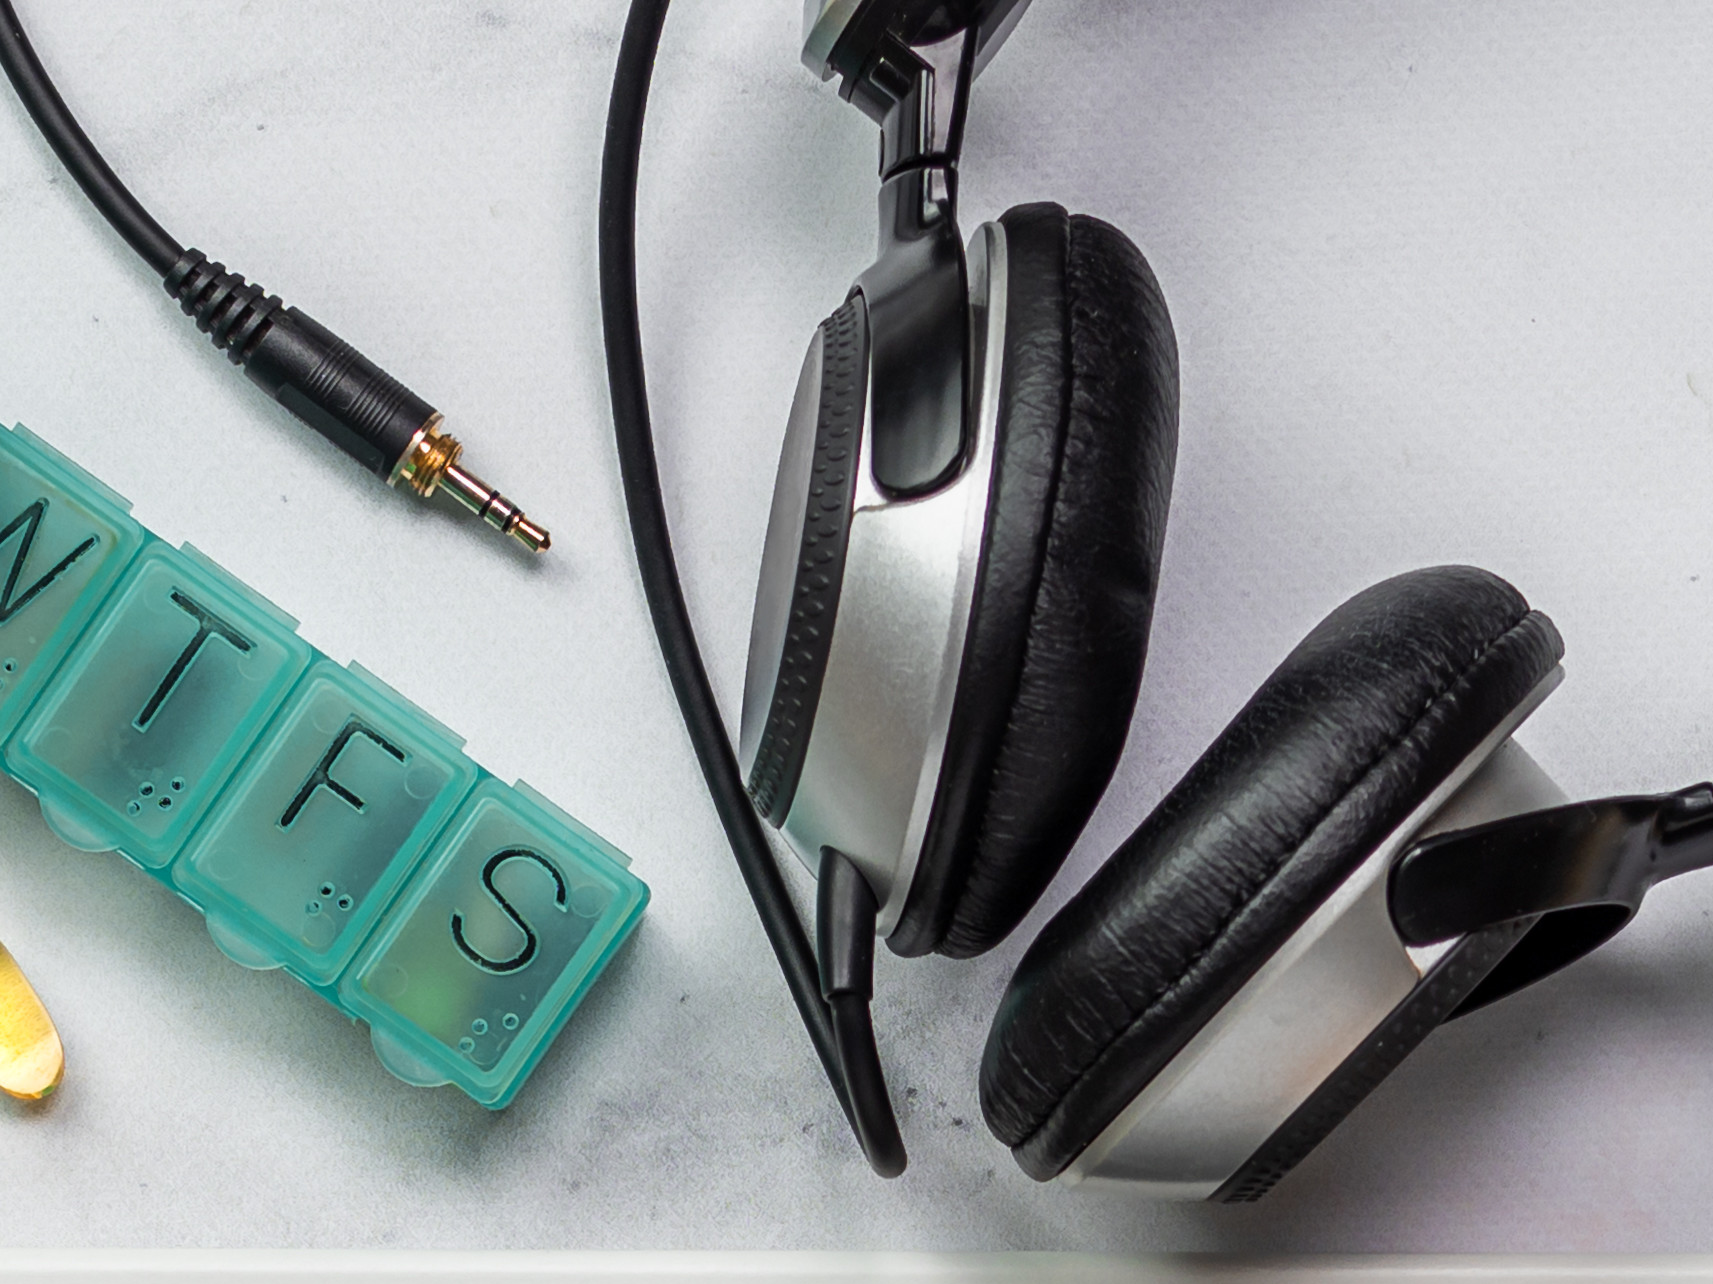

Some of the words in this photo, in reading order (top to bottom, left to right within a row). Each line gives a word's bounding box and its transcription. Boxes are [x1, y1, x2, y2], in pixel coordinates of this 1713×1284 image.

[131, 586, 257, 733] T
[275, 714, 412, 832] F
[450, 844, 569, 976] S
